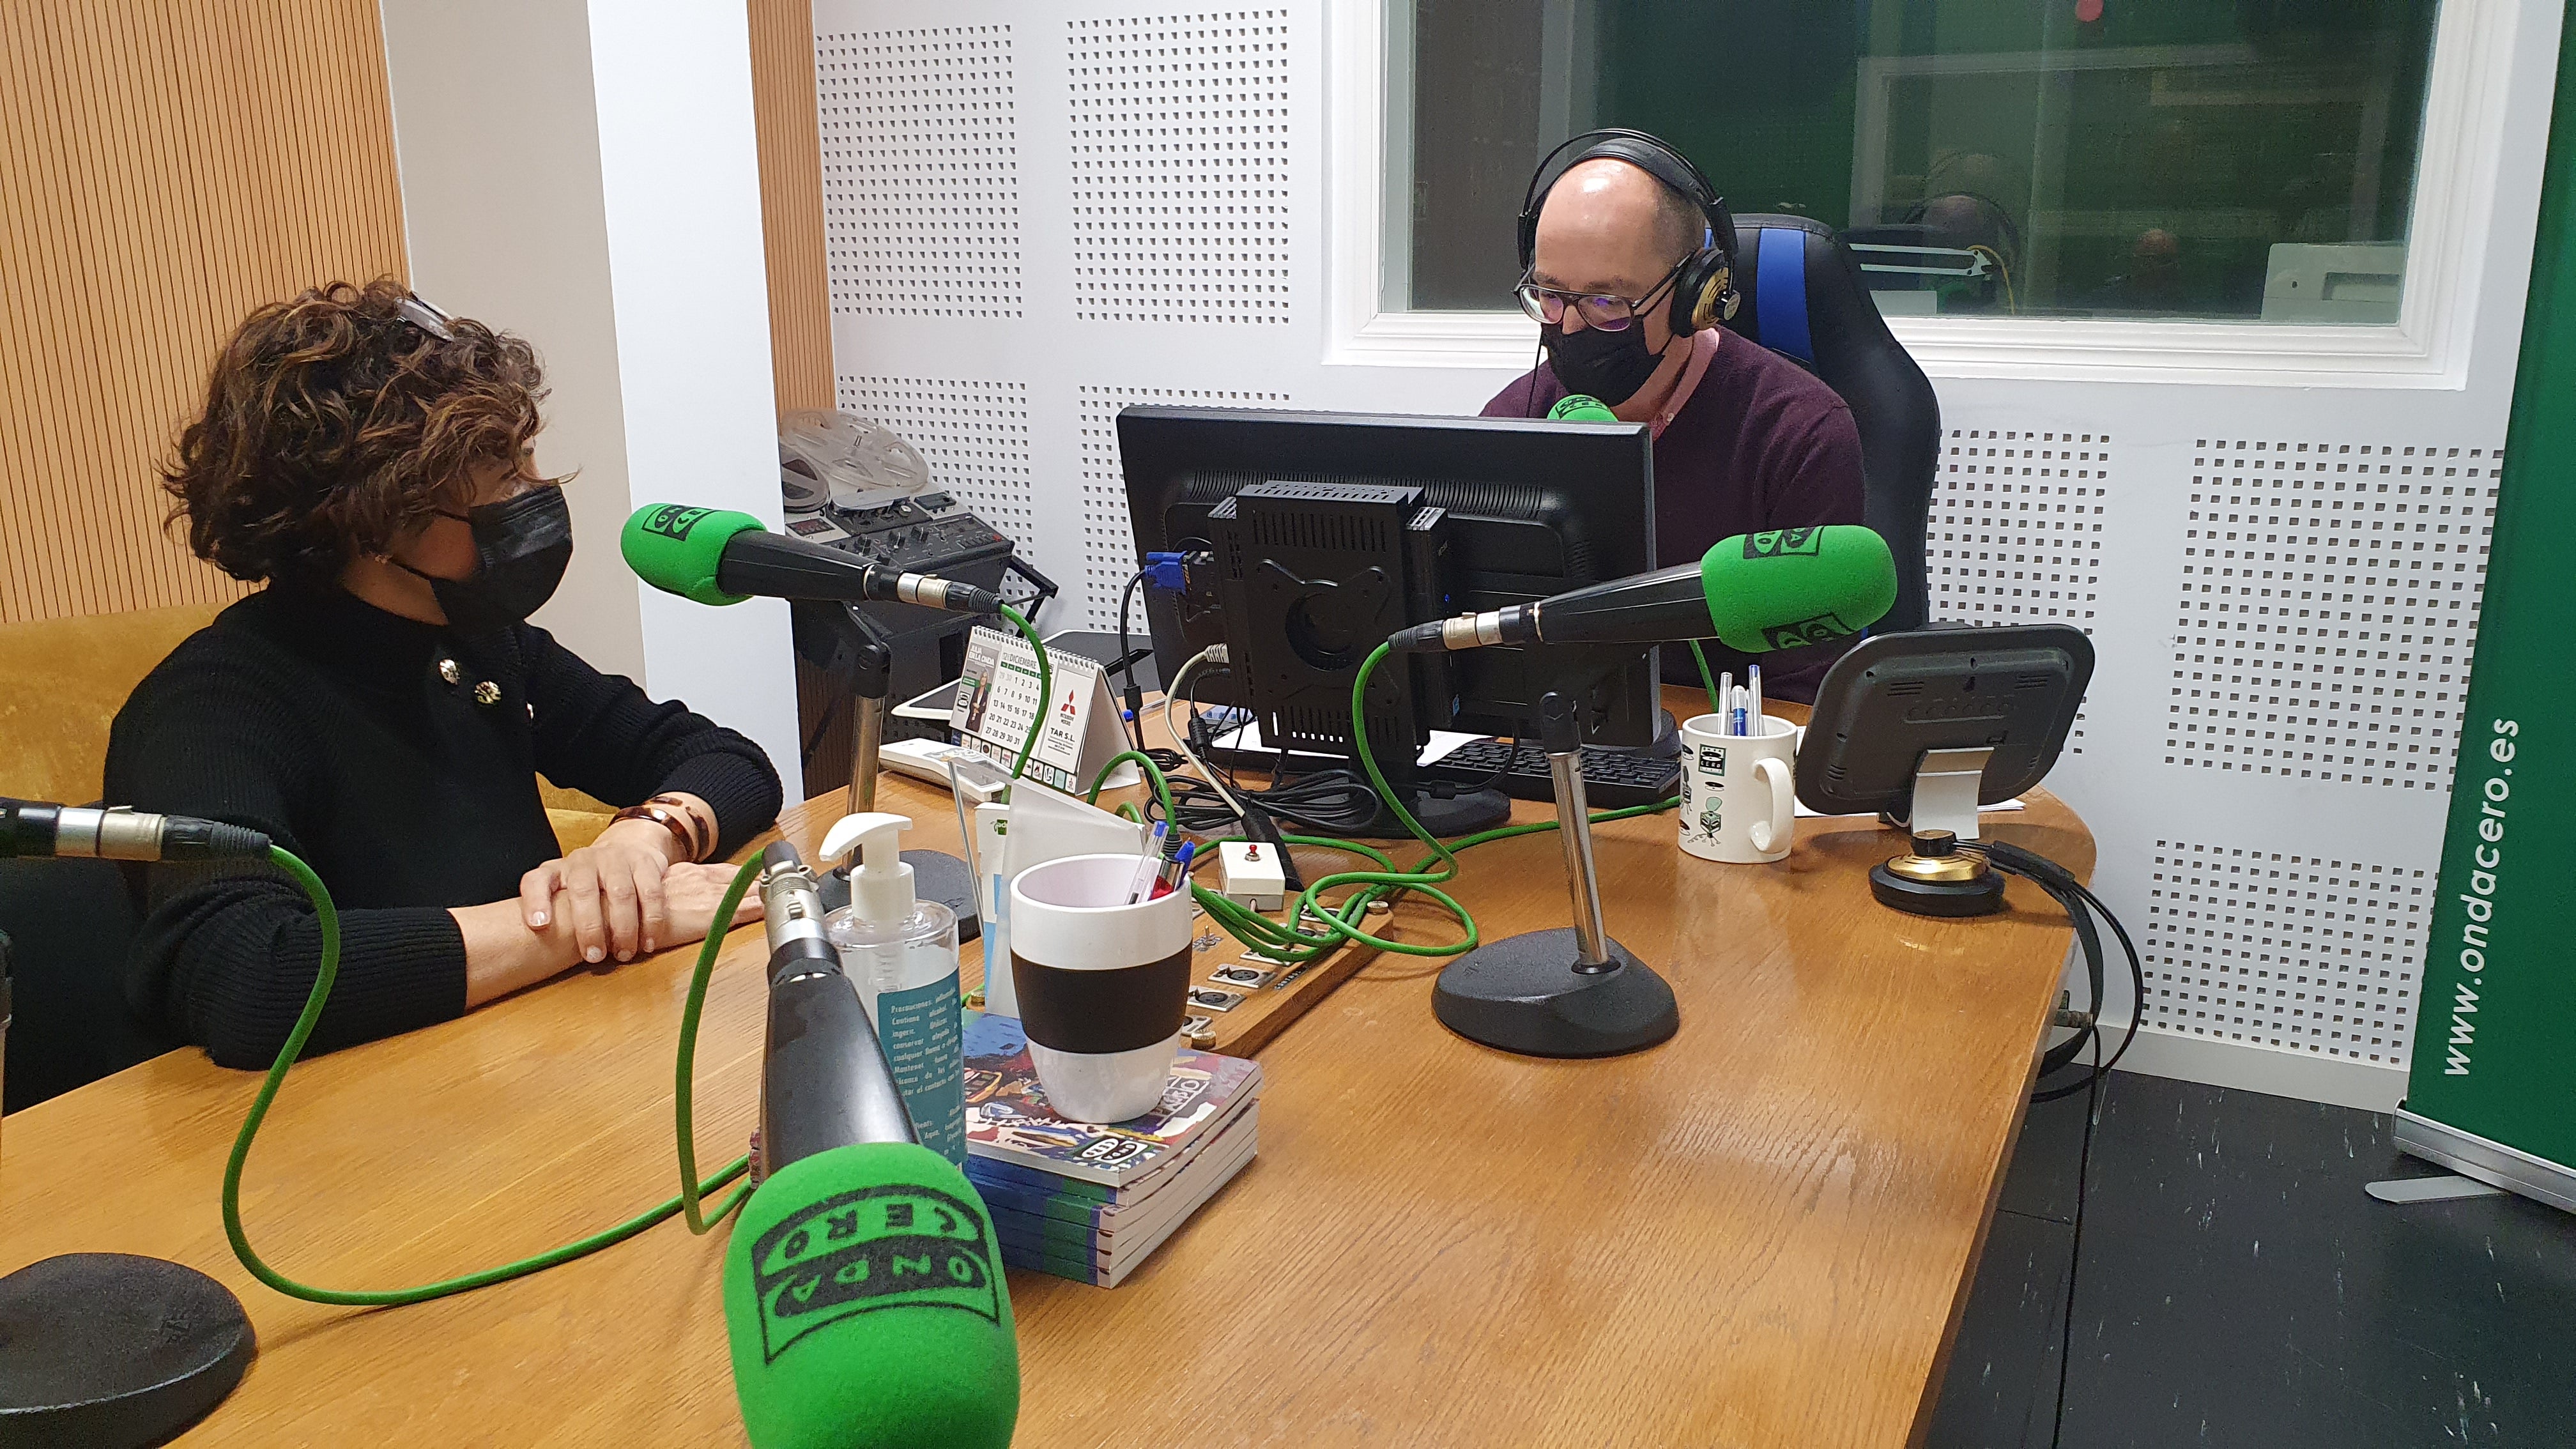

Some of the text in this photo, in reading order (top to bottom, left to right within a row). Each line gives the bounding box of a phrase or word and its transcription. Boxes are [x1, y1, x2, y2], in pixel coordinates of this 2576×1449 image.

[1009, 653, 1038, 670] DICIEMBRE
[1021, 678, 1025, 687] 2
[1025, 695, 1031, 703] 10
[1032, 698, 1038, 706] 11
[1007, 704, 1013, 712] 15
[1015, 707, 1020, 715] 16
[1029, 712, 1034, 720] 18
[988, 712, 995, 721] 20
[996, 715, 1002, 723] 21
[1002, 717, 1009, 726] 22
[1010, 720, 1016, 728] 23
[1017, 723, 1023, 732] 24
[985, 726, 1020, 745] 27 28 29 30 31
[1050, 727, 1063, 738] TAR
[2444, 717, 2519, 1076] www.ondacero.es
[785, 1203, 956, 1259] CERO
[792, 1254, 973, 1303] ONDA
